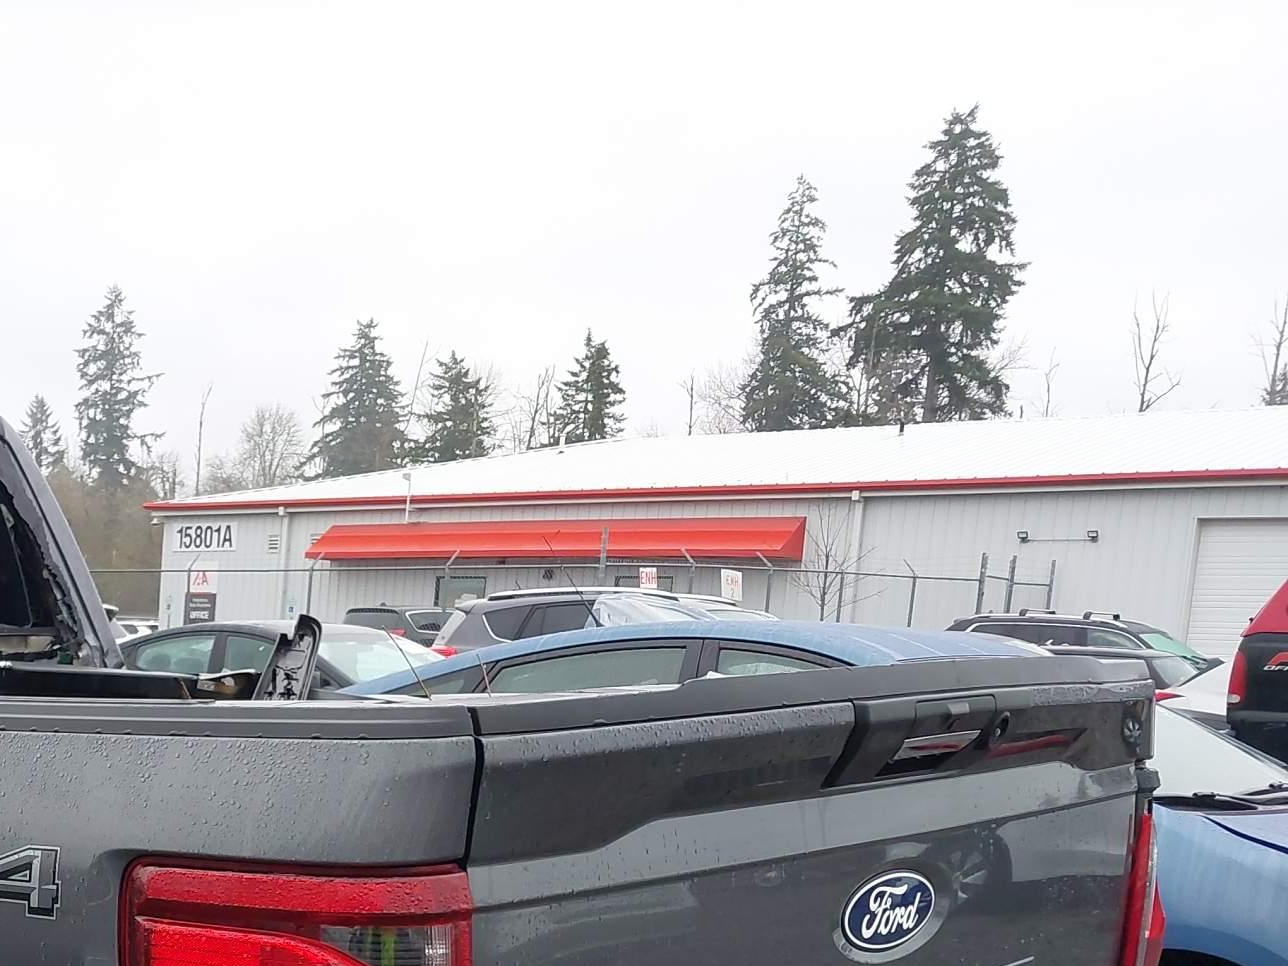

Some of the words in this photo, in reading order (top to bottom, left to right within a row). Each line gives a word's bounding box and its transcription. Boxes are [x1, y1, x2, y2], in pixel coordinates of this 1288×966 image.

[176, 525, 233, 549] 15801A
[640, 570, 657, 585] ENH
[861, 883, 922, 939] Ford
